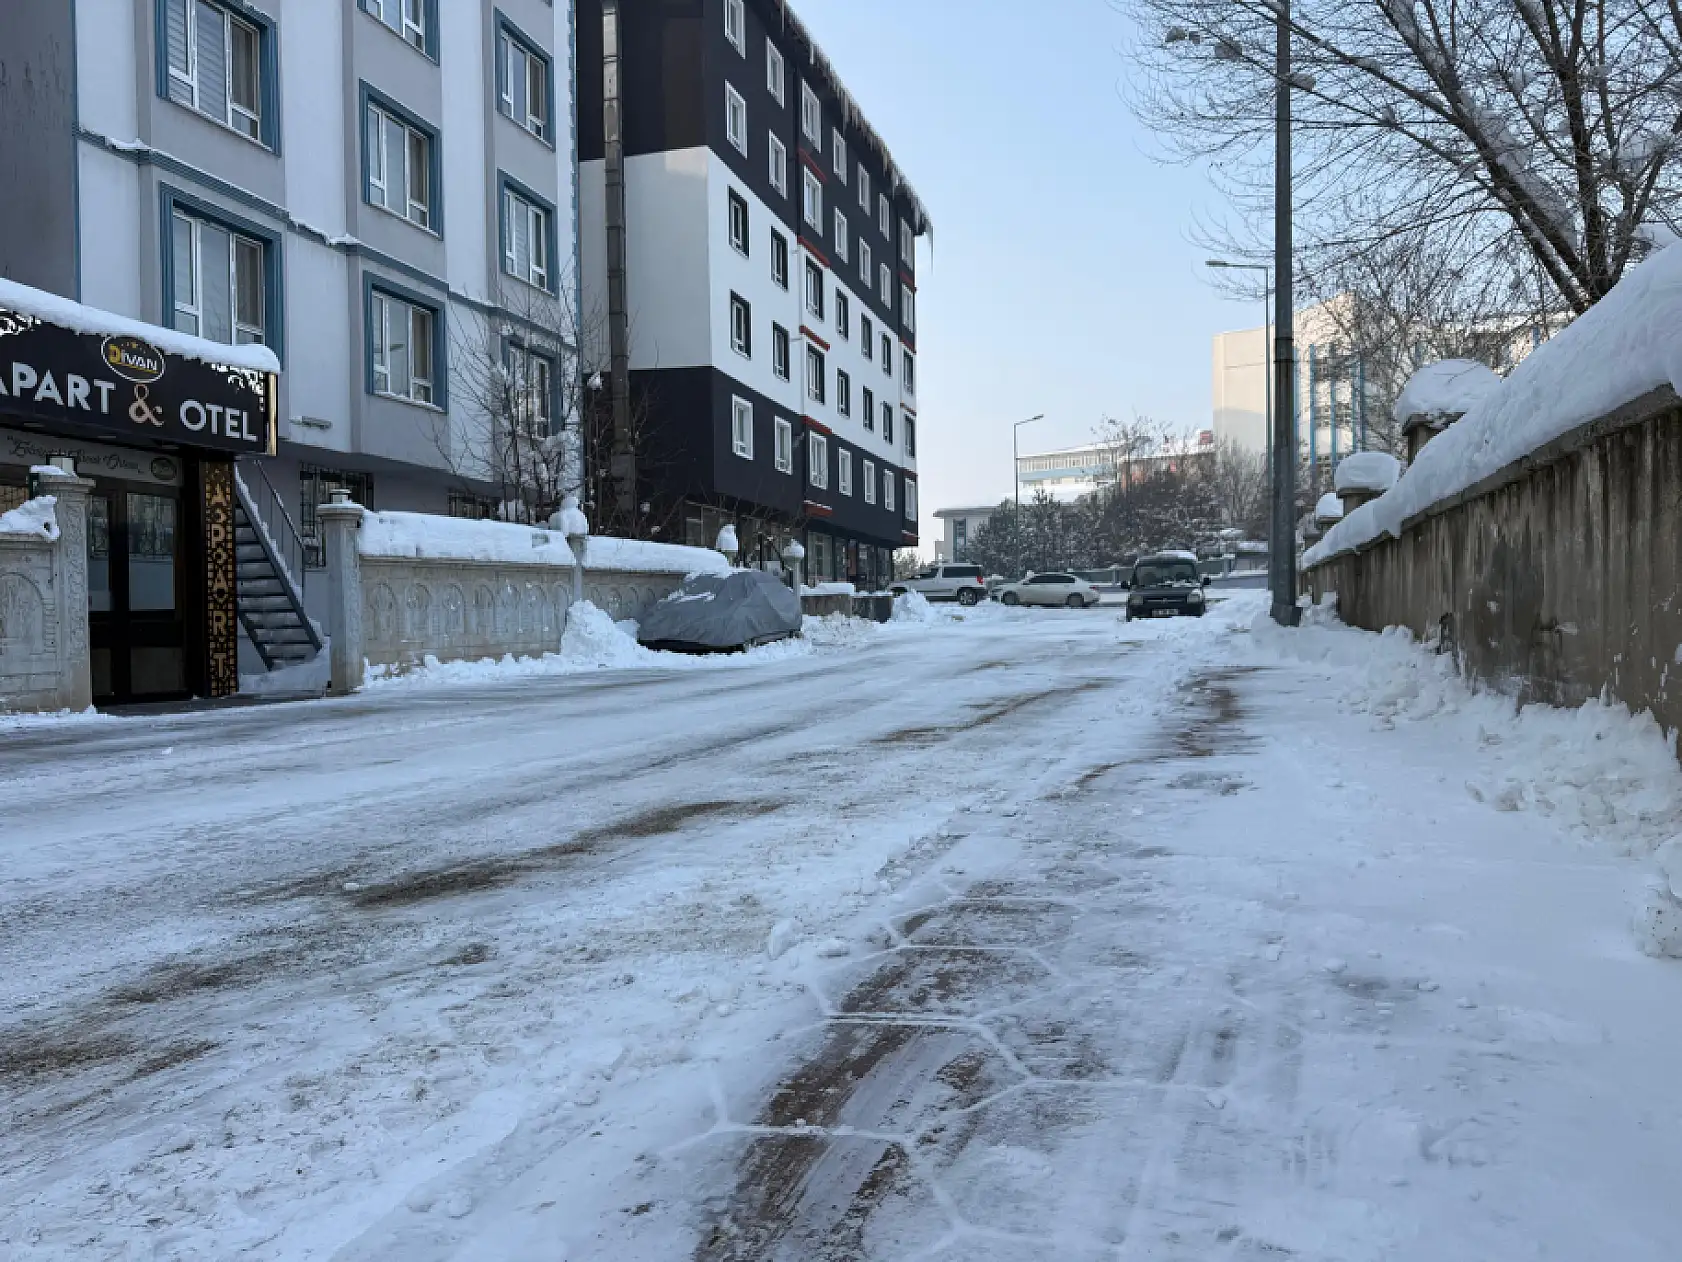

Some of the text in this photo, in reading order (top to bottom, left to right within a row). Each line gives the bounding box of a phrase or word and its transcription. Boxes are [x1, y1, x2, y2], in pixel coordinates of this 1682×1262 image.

[0, 361, 257, 442] PART & OTEL
